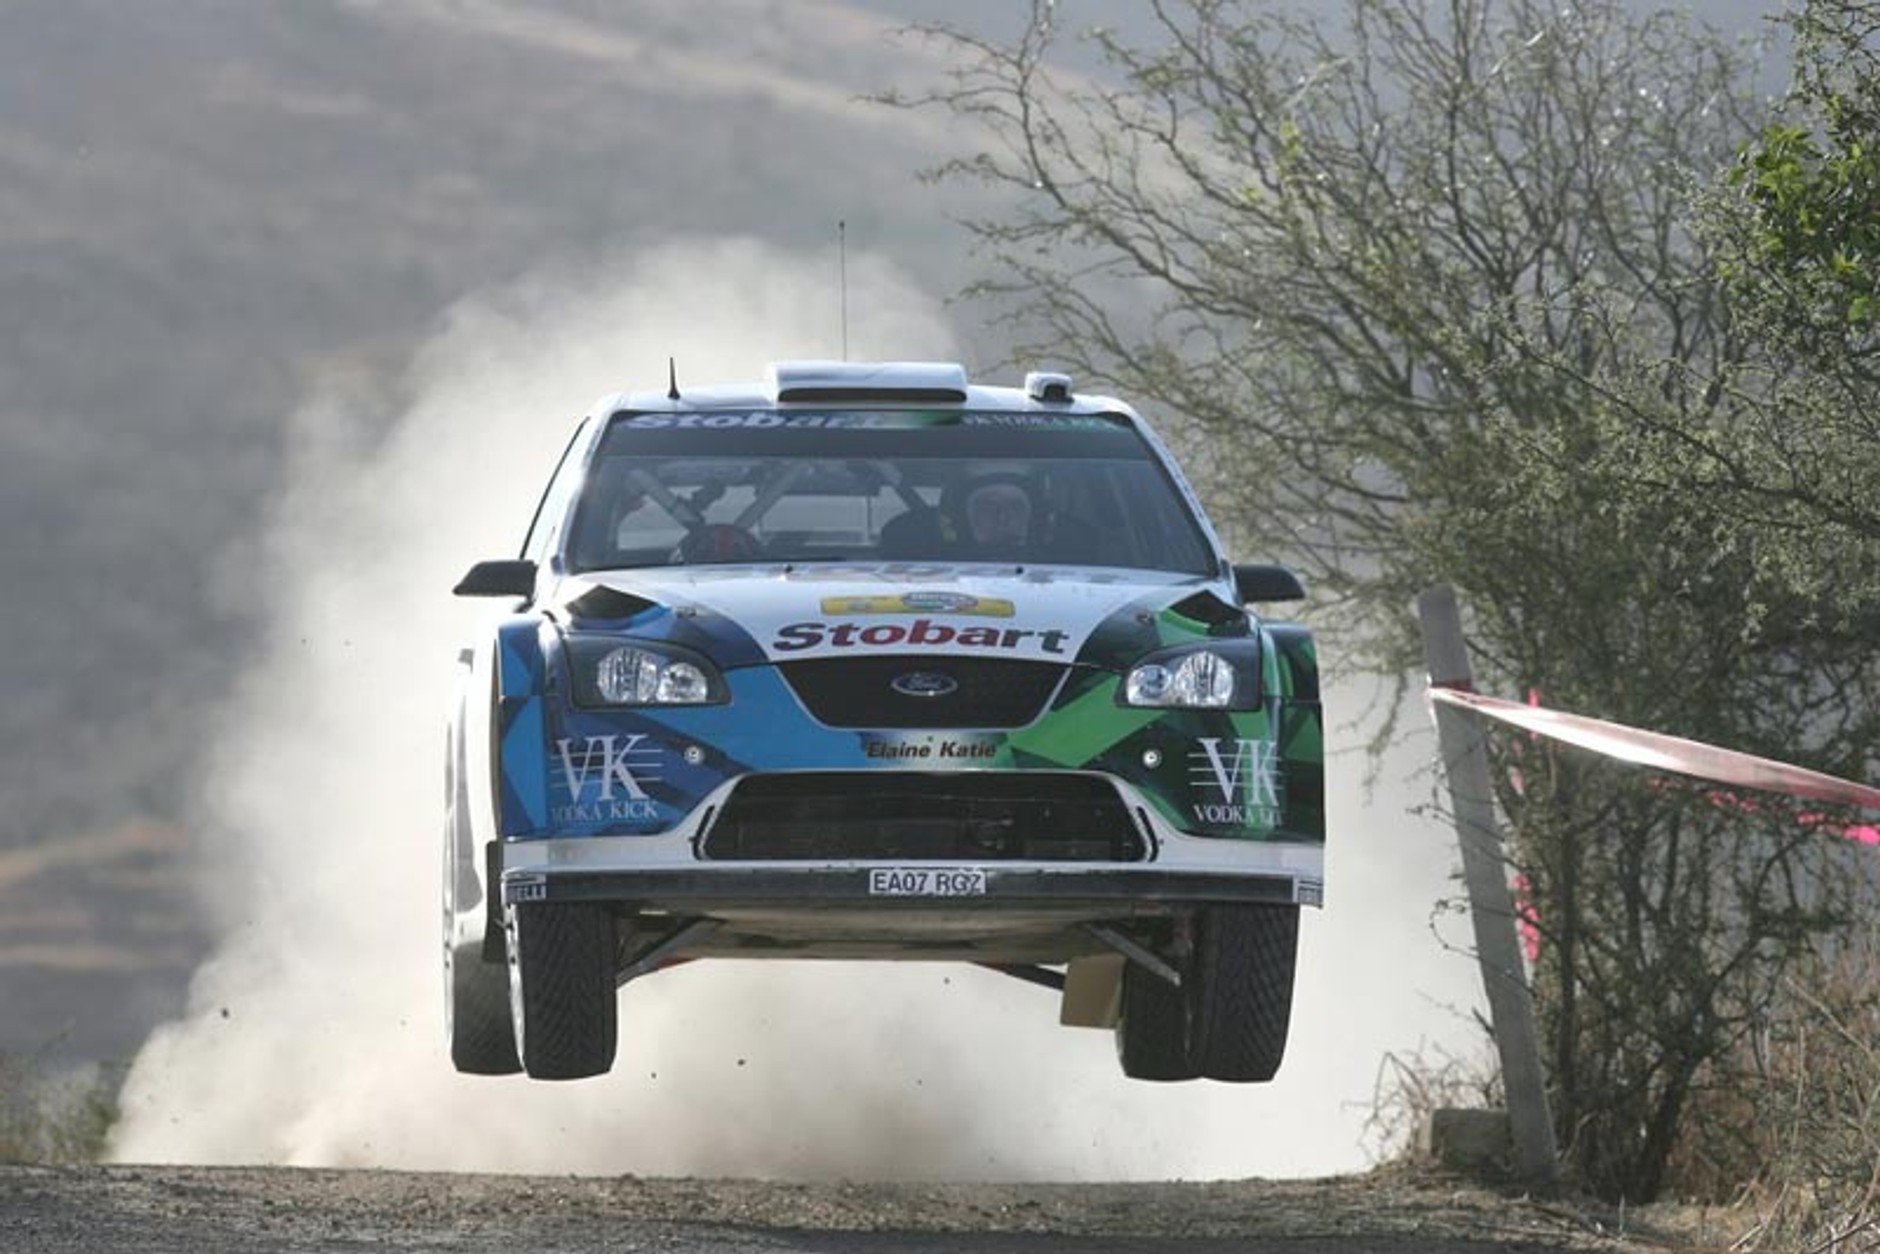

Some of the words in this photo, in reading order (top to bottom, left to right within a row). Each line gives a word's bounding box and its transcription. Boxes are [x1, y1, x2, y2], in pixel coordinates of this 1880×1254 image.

[772, 620, 1070, 653] Stobart
[866, 741, 932, 757] Elaine
[940, 741, 997, 757] Katie
[557, 734, 650, 804] VK
[1199, 737, 1279, 807] VK
[610, 801, 659, 819] KICK
[873, 872, 928, 892] EA07
